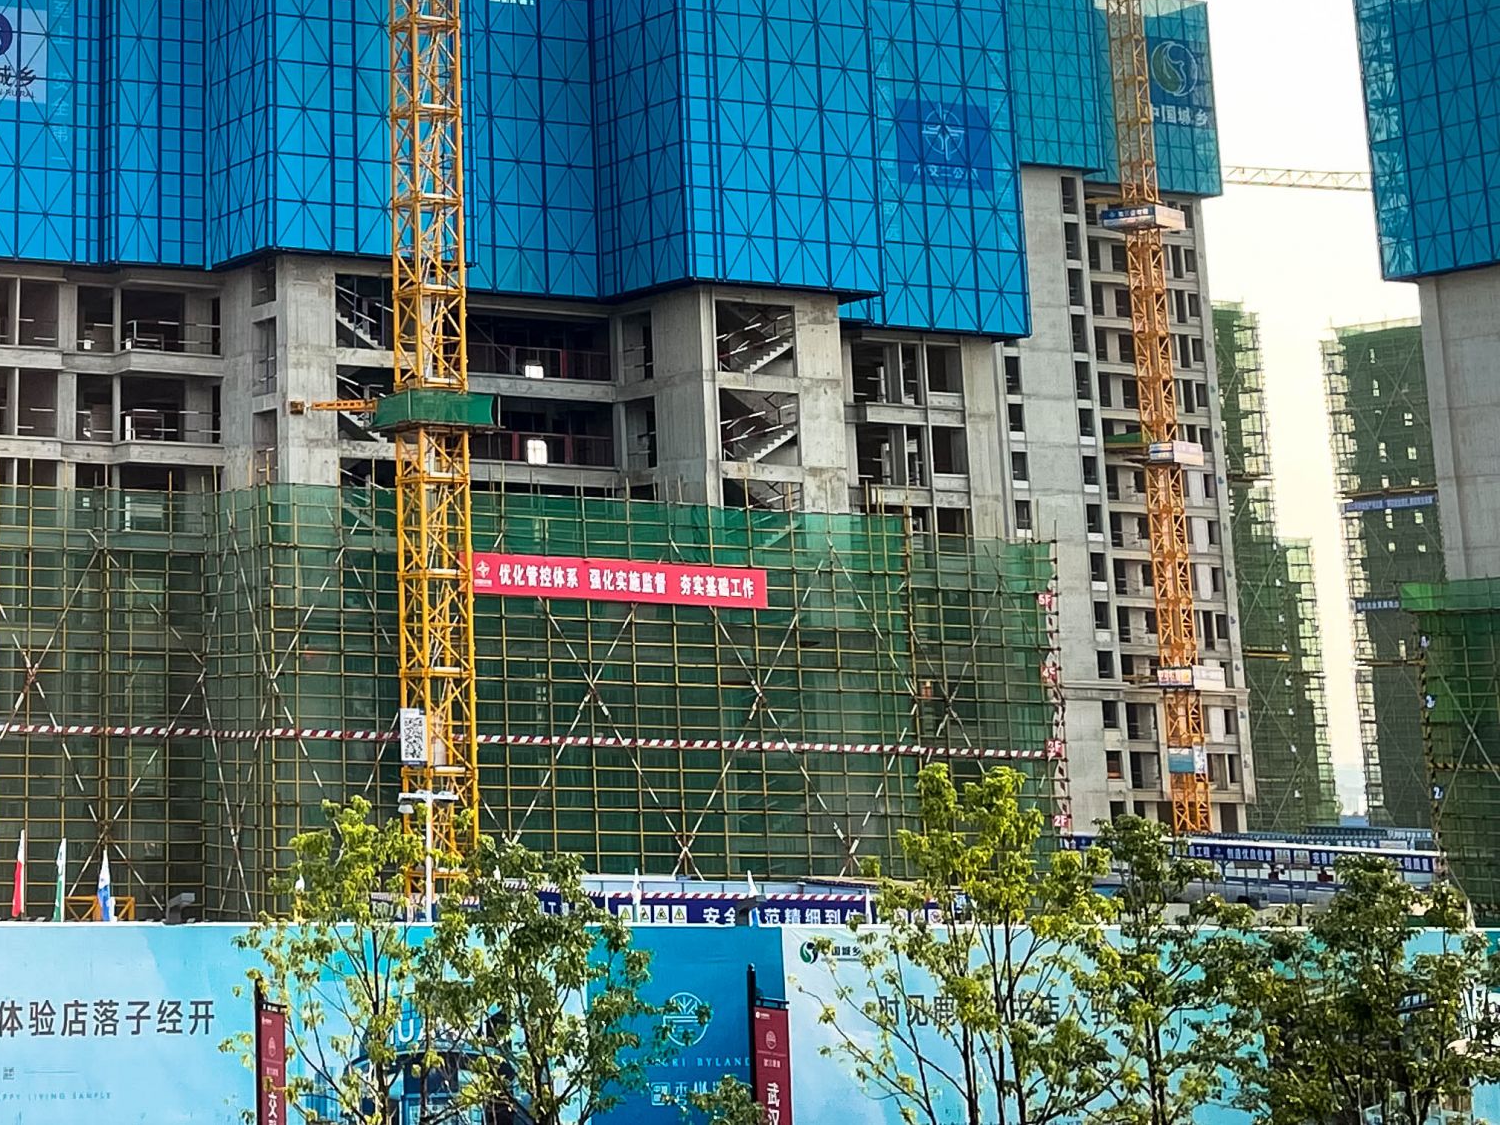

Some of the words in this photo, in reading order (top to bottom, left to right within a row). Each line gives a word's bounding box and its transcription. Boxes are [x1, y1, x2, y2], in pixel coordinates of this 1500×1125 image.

[499, 564, 579, 588] 优化管控体系
[588, 567, 667, 595] 强化实施监督
[680, 574, 755, 599] 夯实基础工作
[1038, 594, 1052, 606] 5F
[1053, 816, 1068, 827] 2F
